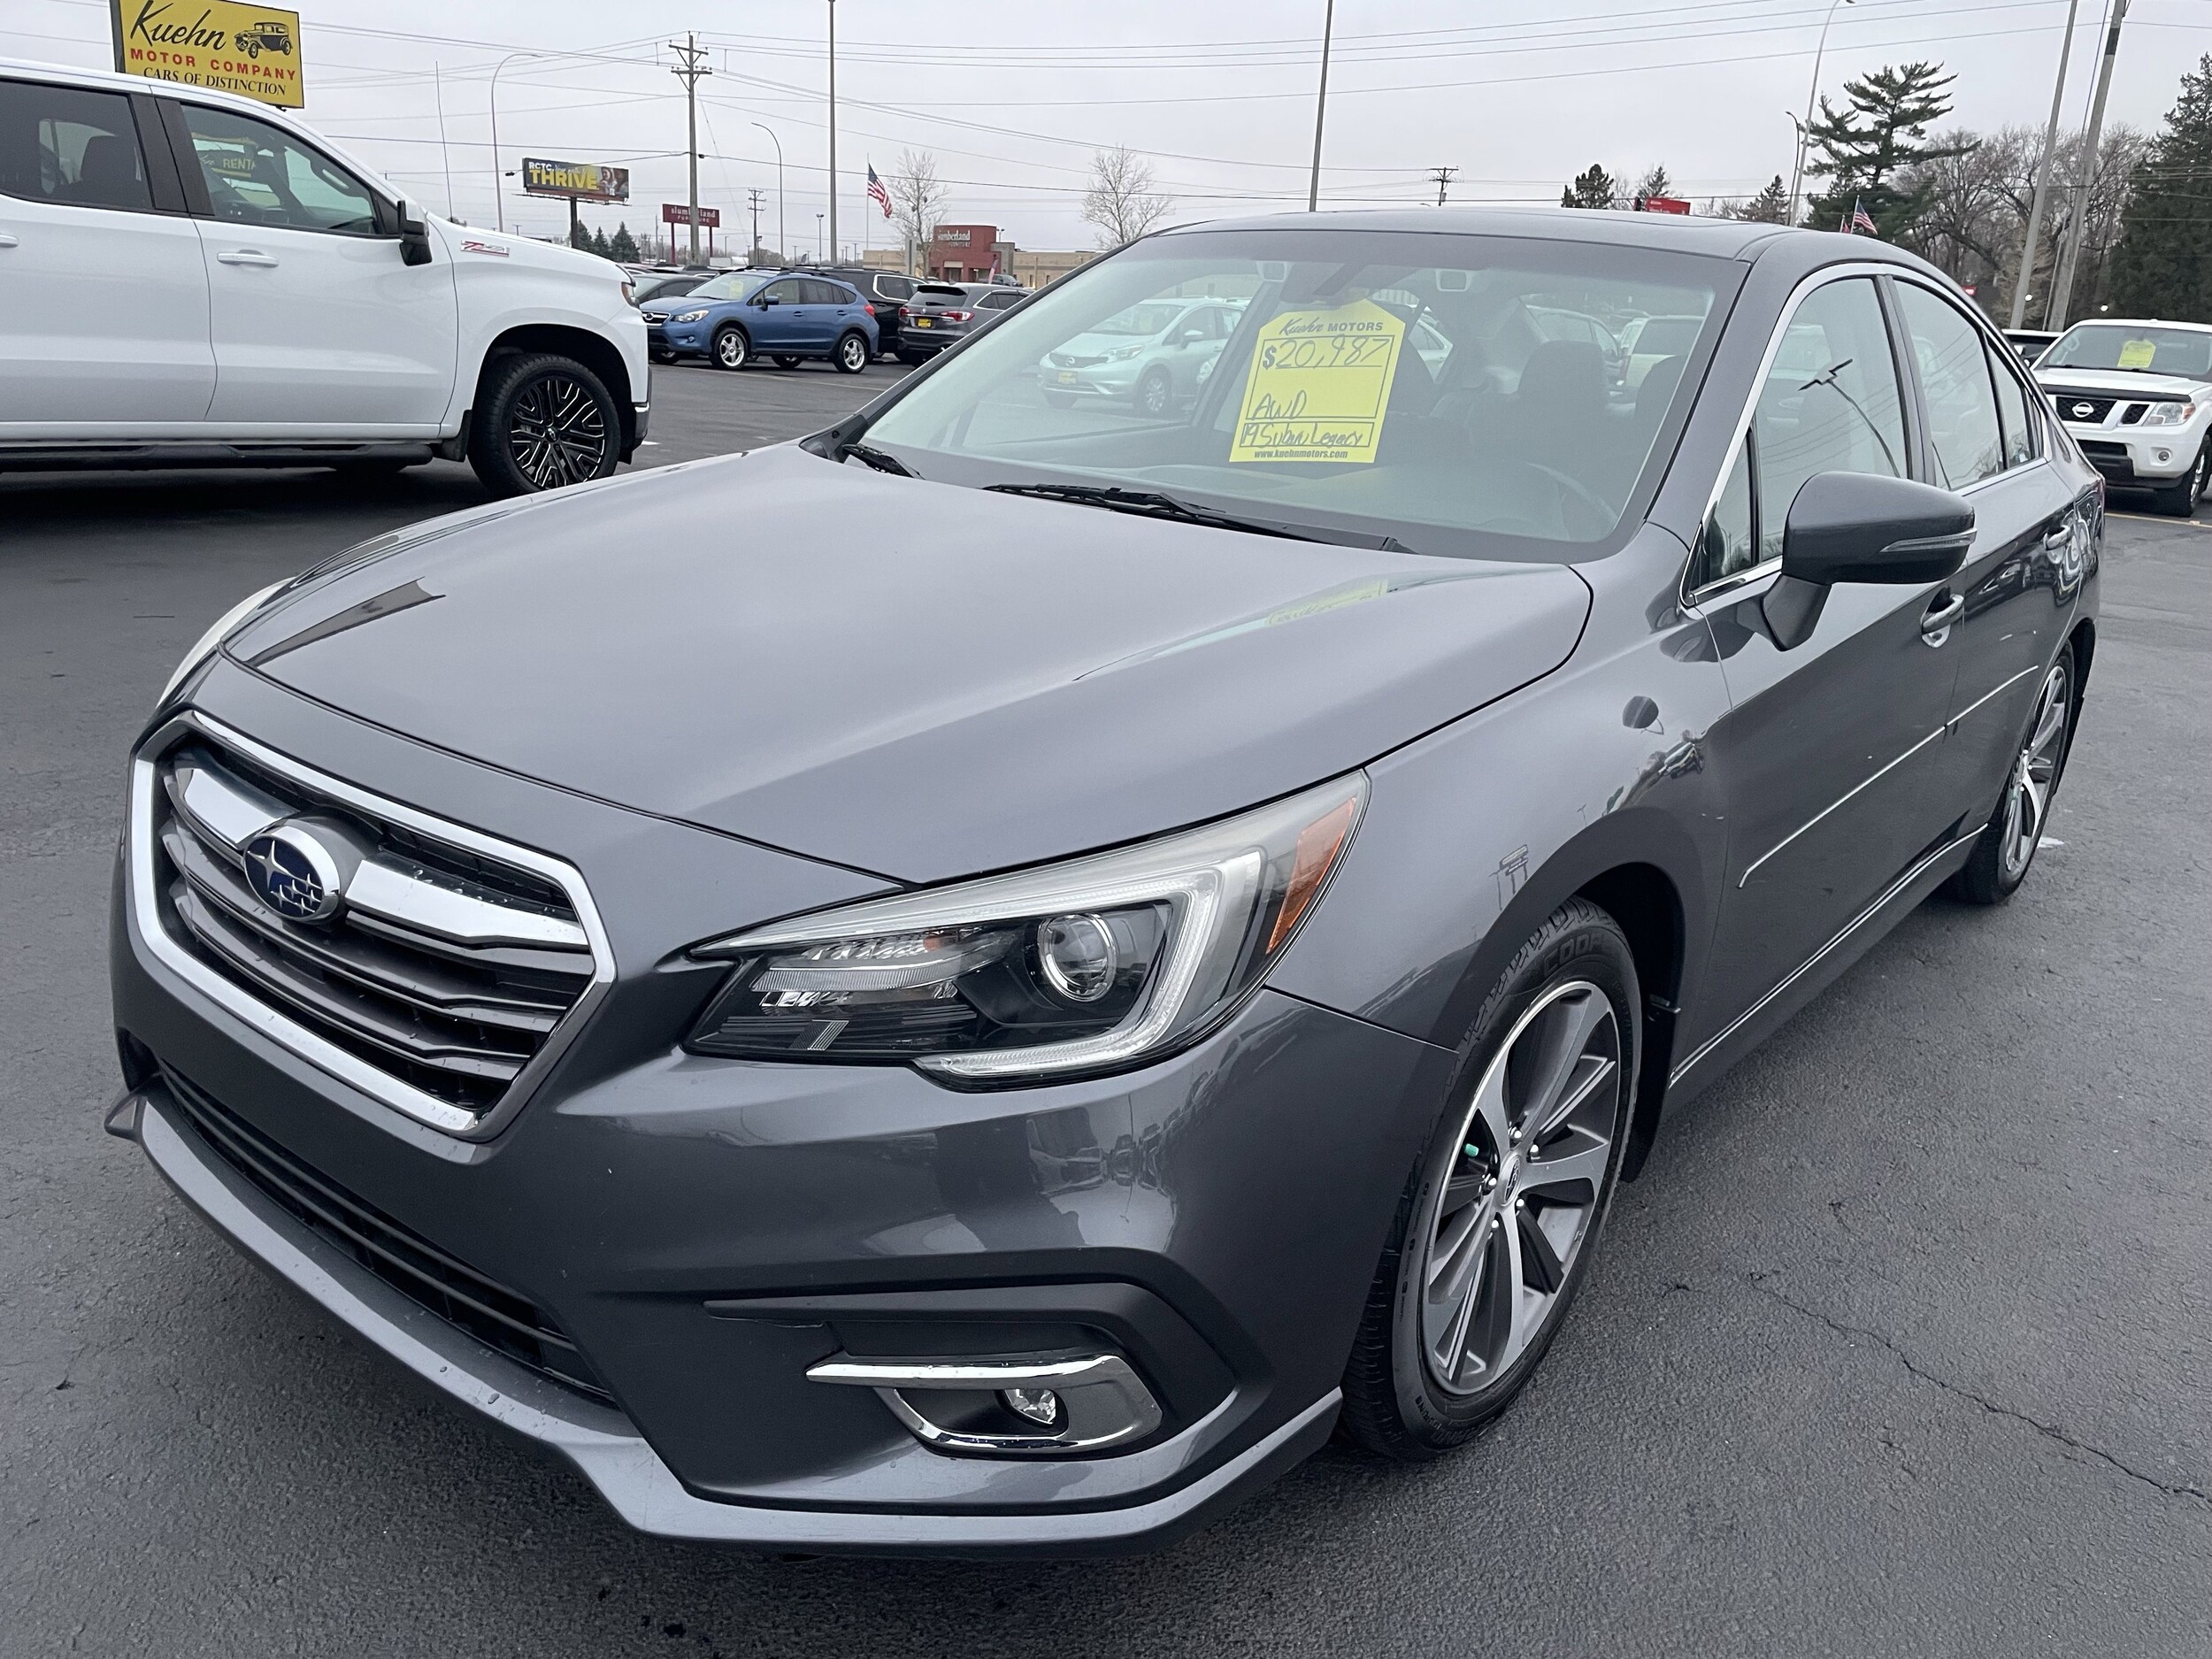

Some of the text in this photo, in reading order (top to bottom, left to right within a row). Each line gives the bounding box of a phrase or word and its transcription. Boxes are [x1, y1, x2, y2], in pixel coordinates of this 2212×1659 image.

[130, 0, 227, 50] Kuehn
[130, 48, 296, 81] MOTOR COMPANY
[143, 66, 286, 96] CARS OF DISTINCTION
[671, 205, 716, 218] slumland
[1279, 317, 1383, 335] Kuehn MOTORS
[1310, 422, 1363, 449] Legacy
[1254, 449, 1348, 459] www.kuehnmotors.com
